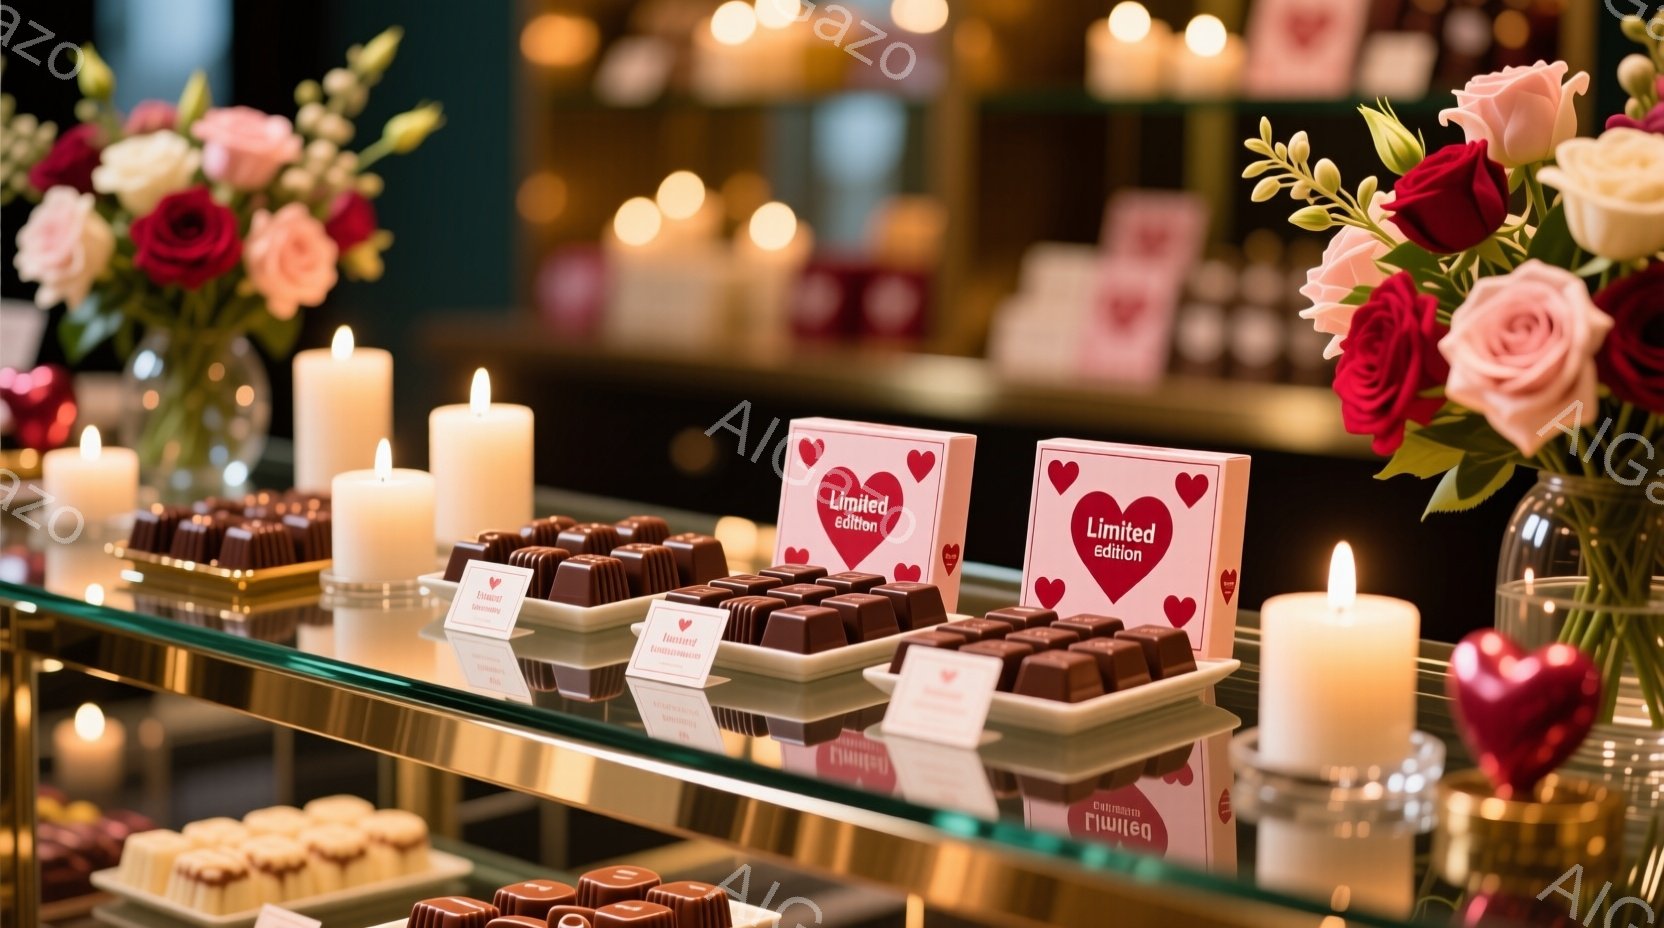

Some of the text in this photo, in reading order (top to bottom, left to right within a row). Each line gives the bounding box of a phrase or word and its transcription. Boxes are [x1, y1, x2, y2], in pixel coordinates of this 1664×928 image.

[829, 489, 889, 516] Limited
[834, 515, 878, 533] edition
[1086, 516, 1156, 544] Limited
[1094, 543, 1142, 562] edition
